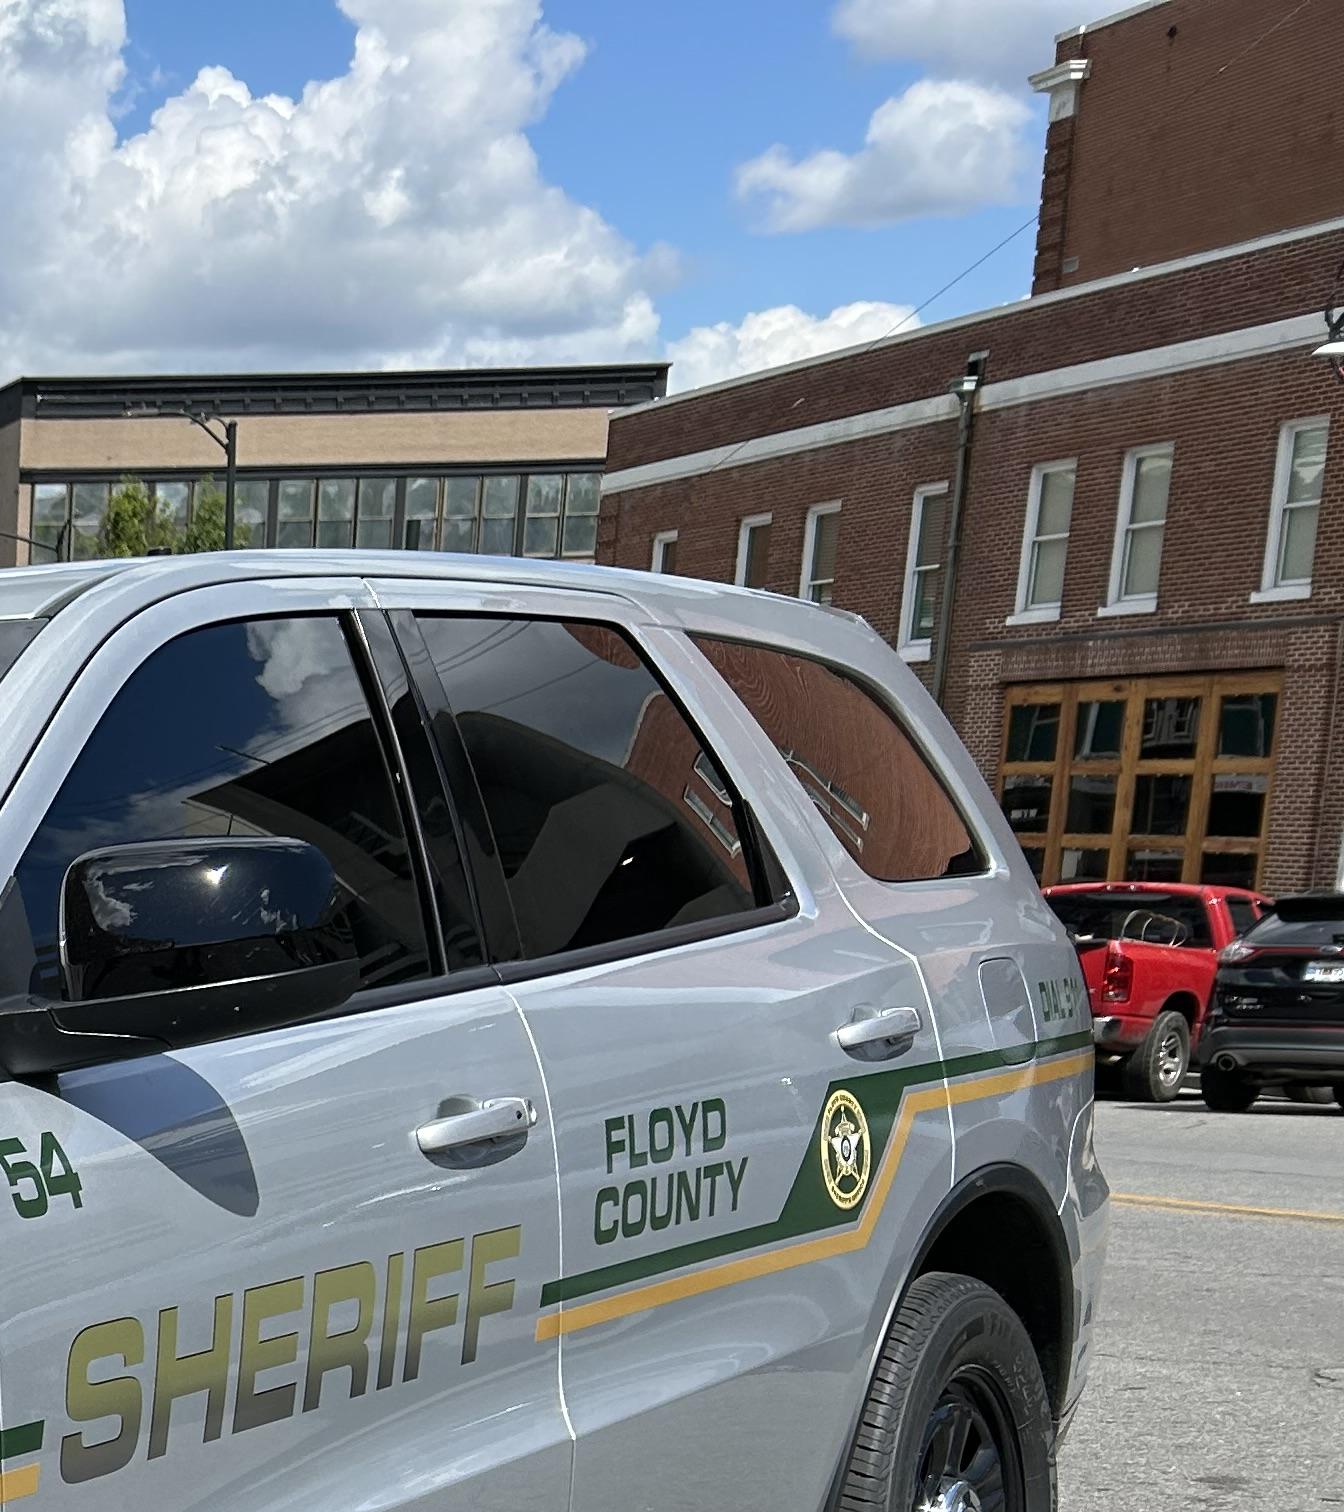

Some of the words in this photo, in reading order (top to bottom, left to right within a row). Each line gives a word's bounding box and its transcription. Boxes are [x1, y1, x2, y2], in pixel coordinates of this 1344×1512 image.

[1038, 979, 1066, 1022] DIAL
[606, 1097, 728, 1170] FLOYD
[593, 1157, 749, 1246] COUNTY
[60, 1223, 522, 1485] SHERIFF
